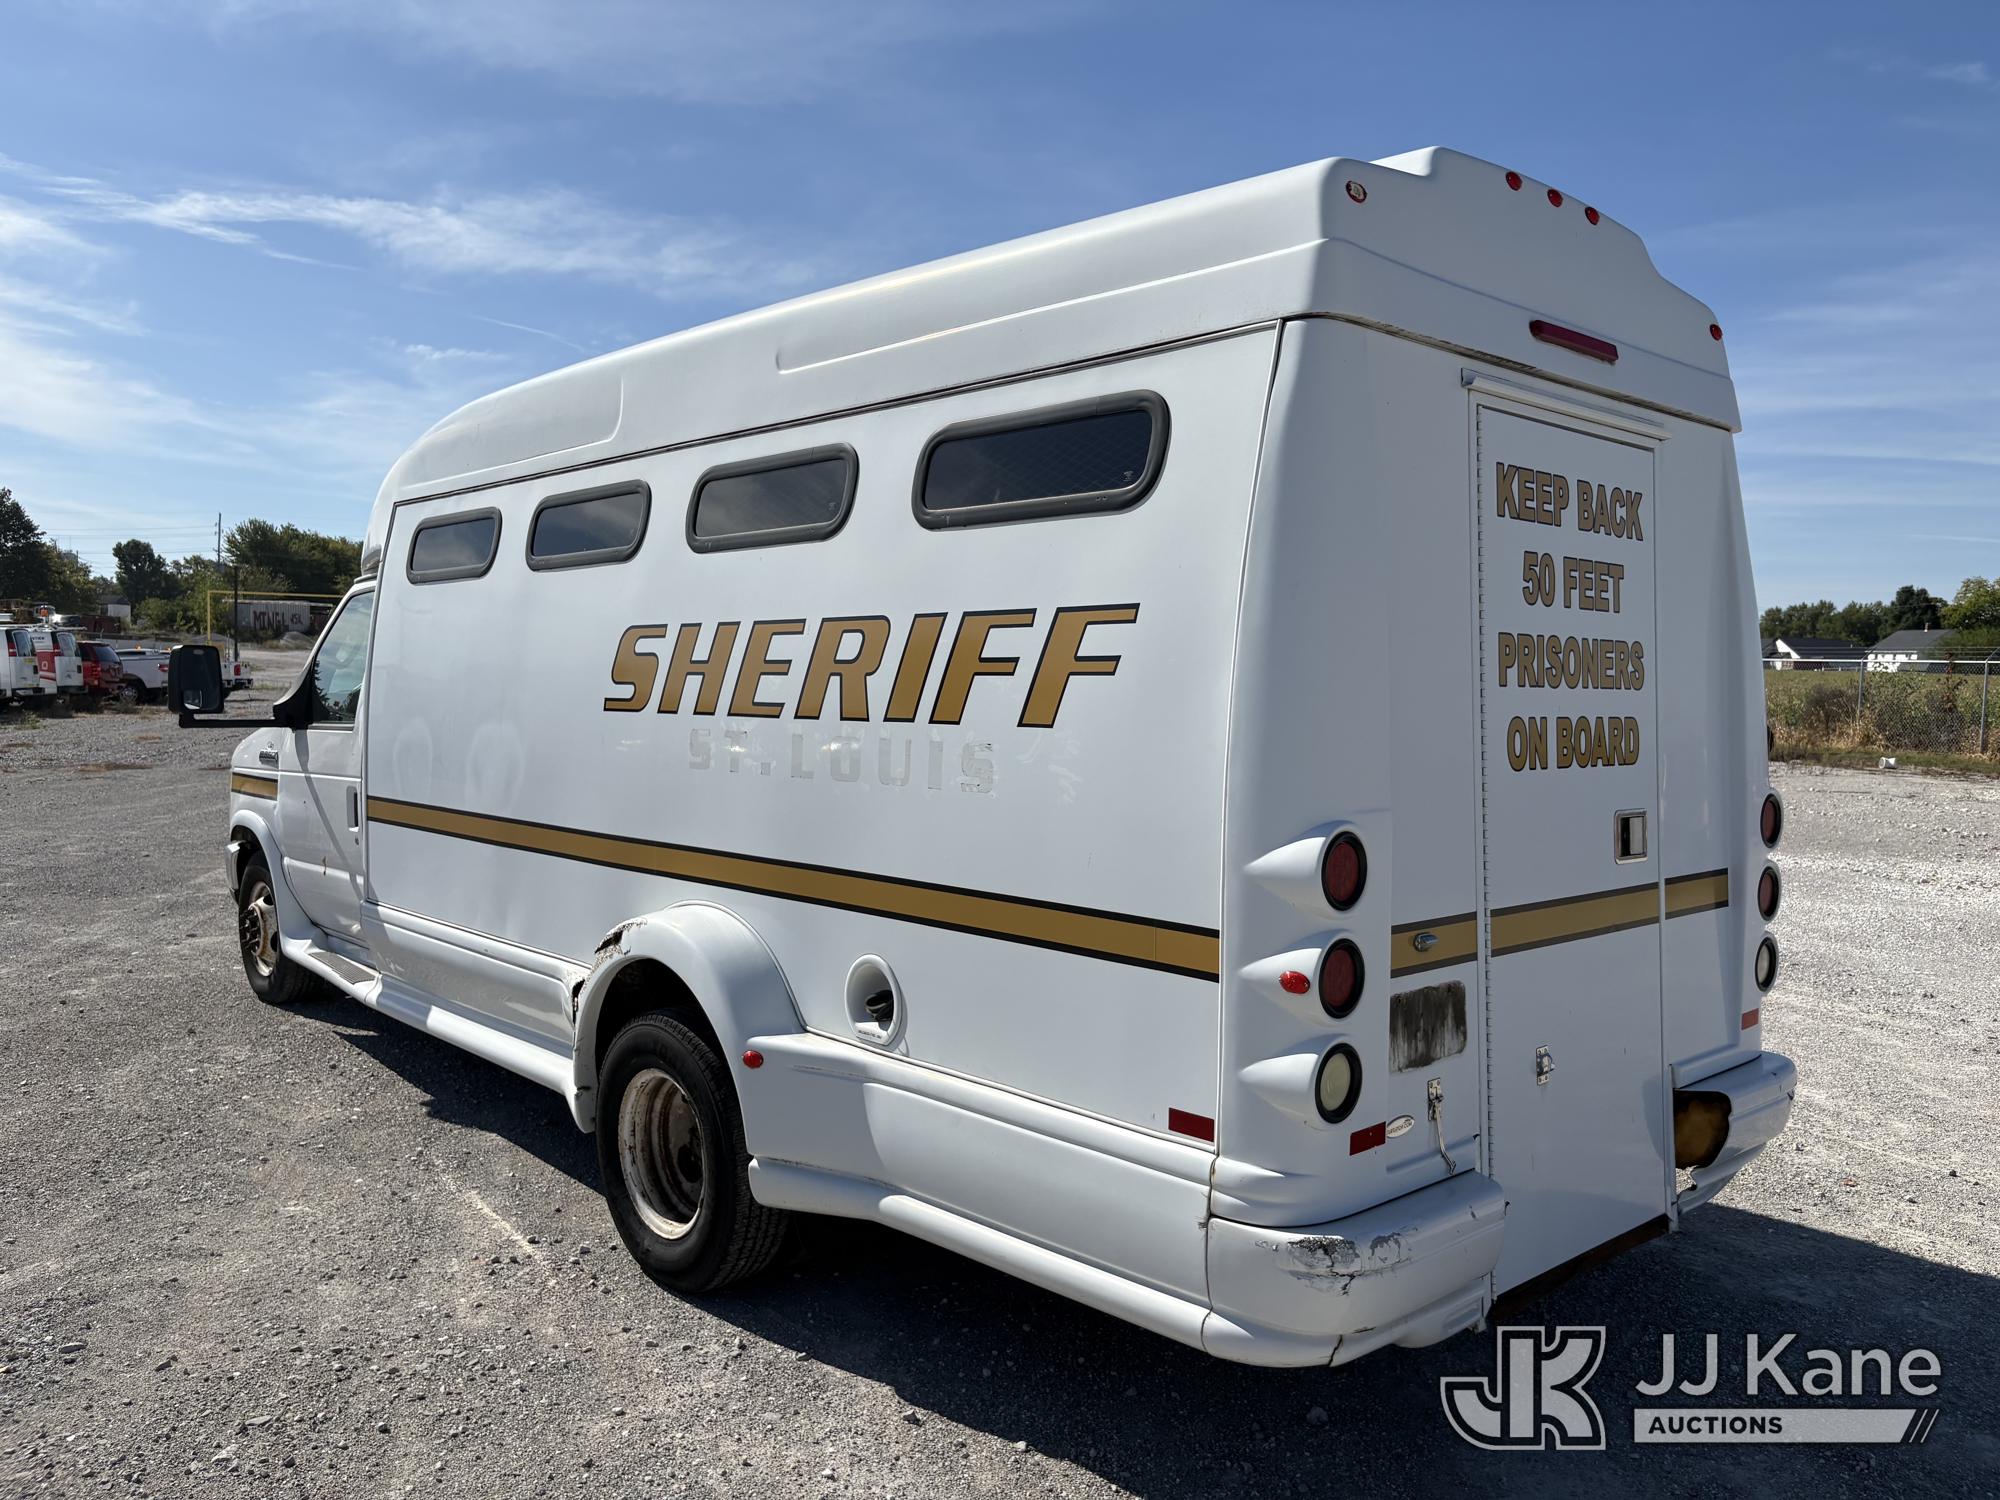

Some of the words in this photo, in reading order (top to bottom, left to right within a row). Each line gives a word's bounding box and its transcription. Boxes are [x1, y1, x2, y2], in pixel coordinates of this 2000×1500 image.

[1496, 462, 1569, 527] KEEP
[1577, 480, 1644, 541] BACK
[1522, 551, 1556, 607] 50
[1563, 557, 1624, 613] FEET
[603, 602, 1141, 728] SHERIFF
[1498, 632, 1645, 691] PRISONERS
[688, 728, 772, 776] ST.
[790, 733, 995, 794] LOUIS
[1507, 716, 1548, 772] ON
[1556, 716, 1640, 769] BOARD
